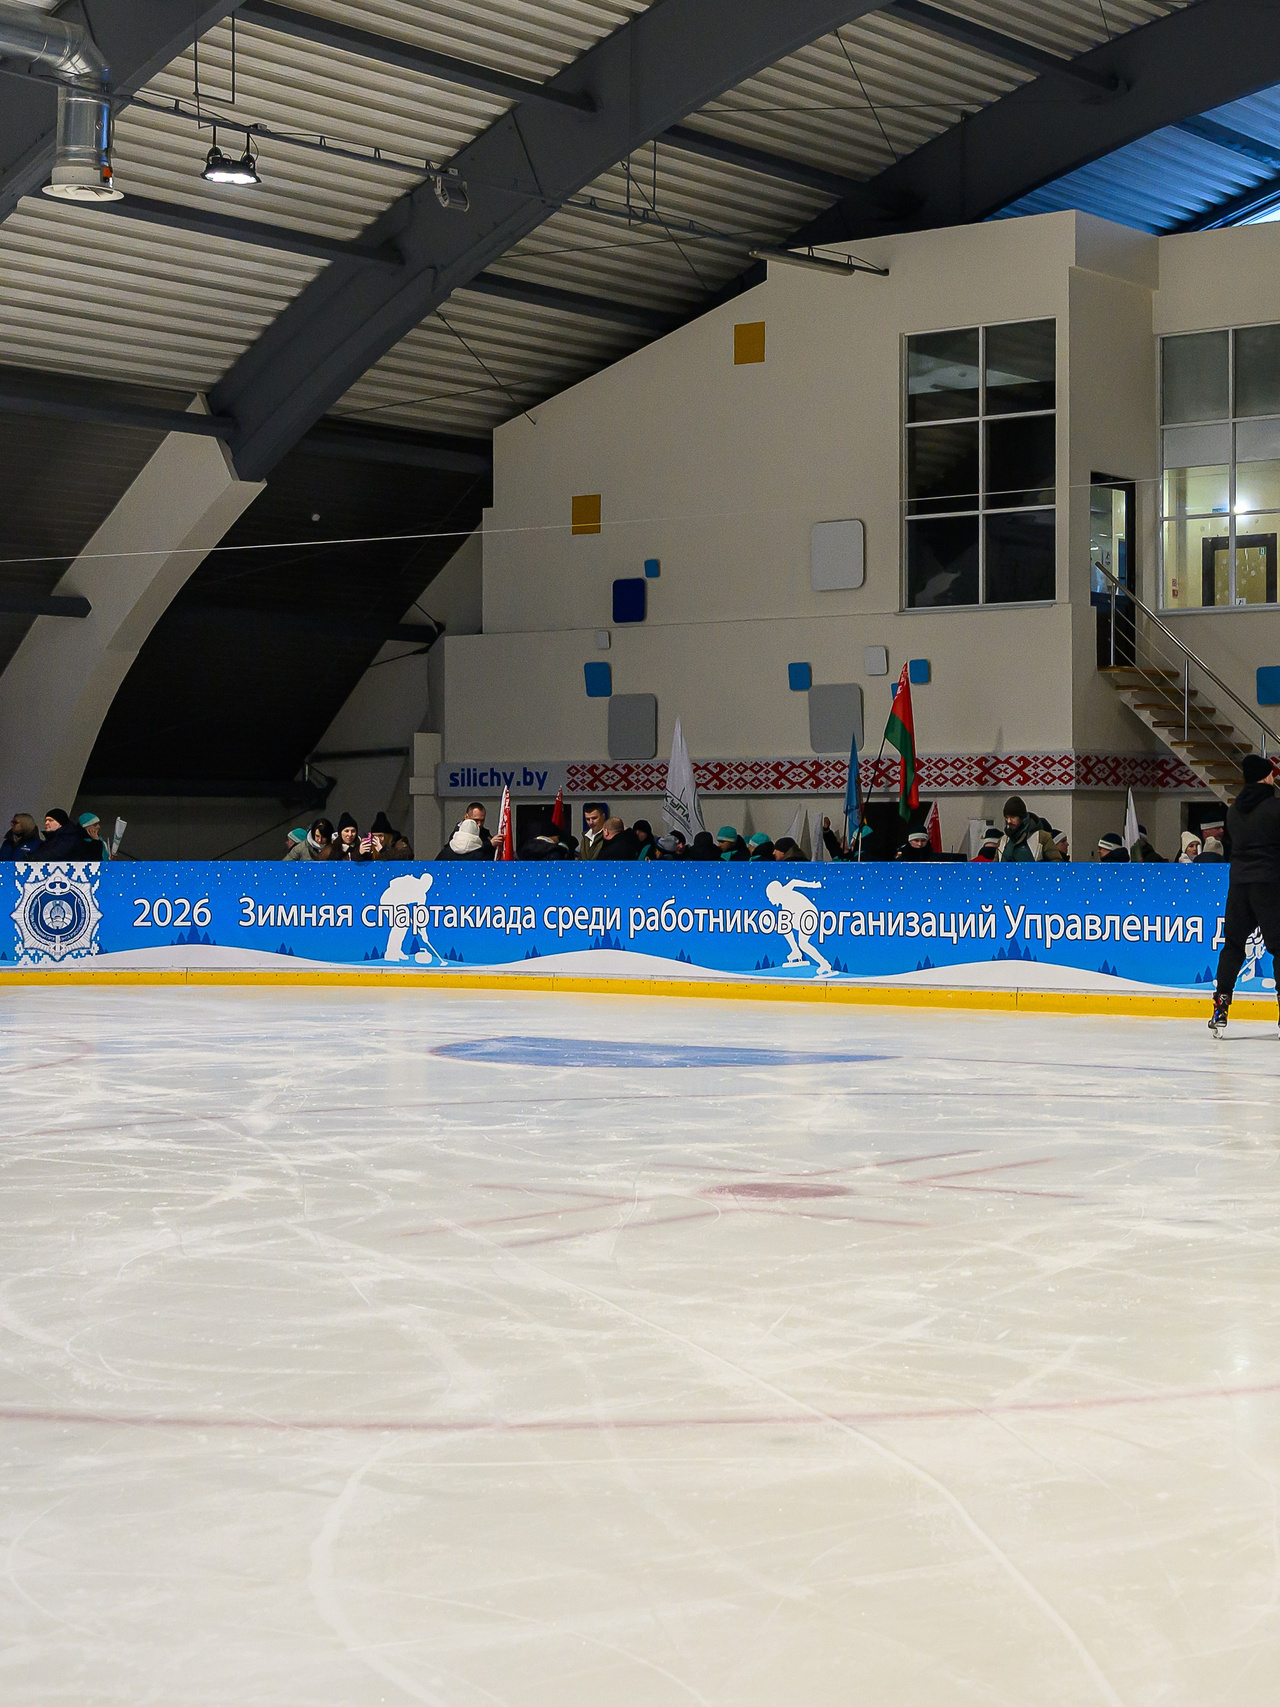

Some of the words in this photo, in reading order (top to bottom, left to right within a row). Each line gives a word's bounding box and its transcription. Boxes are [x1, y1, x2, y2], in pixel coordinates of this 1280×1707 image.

[449, 767, 548, 790] silichy.by
[664, 793, 691, 823] КУПА
[132, 897, 212, 927] 2026
[238, 897, 354, 927] Зимняя
[361, 903, 536, 935] спартакиада
[543, 905, 622, 937] среди
[629, 898, 794, 939] работников
[799, 904, 997, 945] организаций
[1004, 904, 1204, 949] Управления
